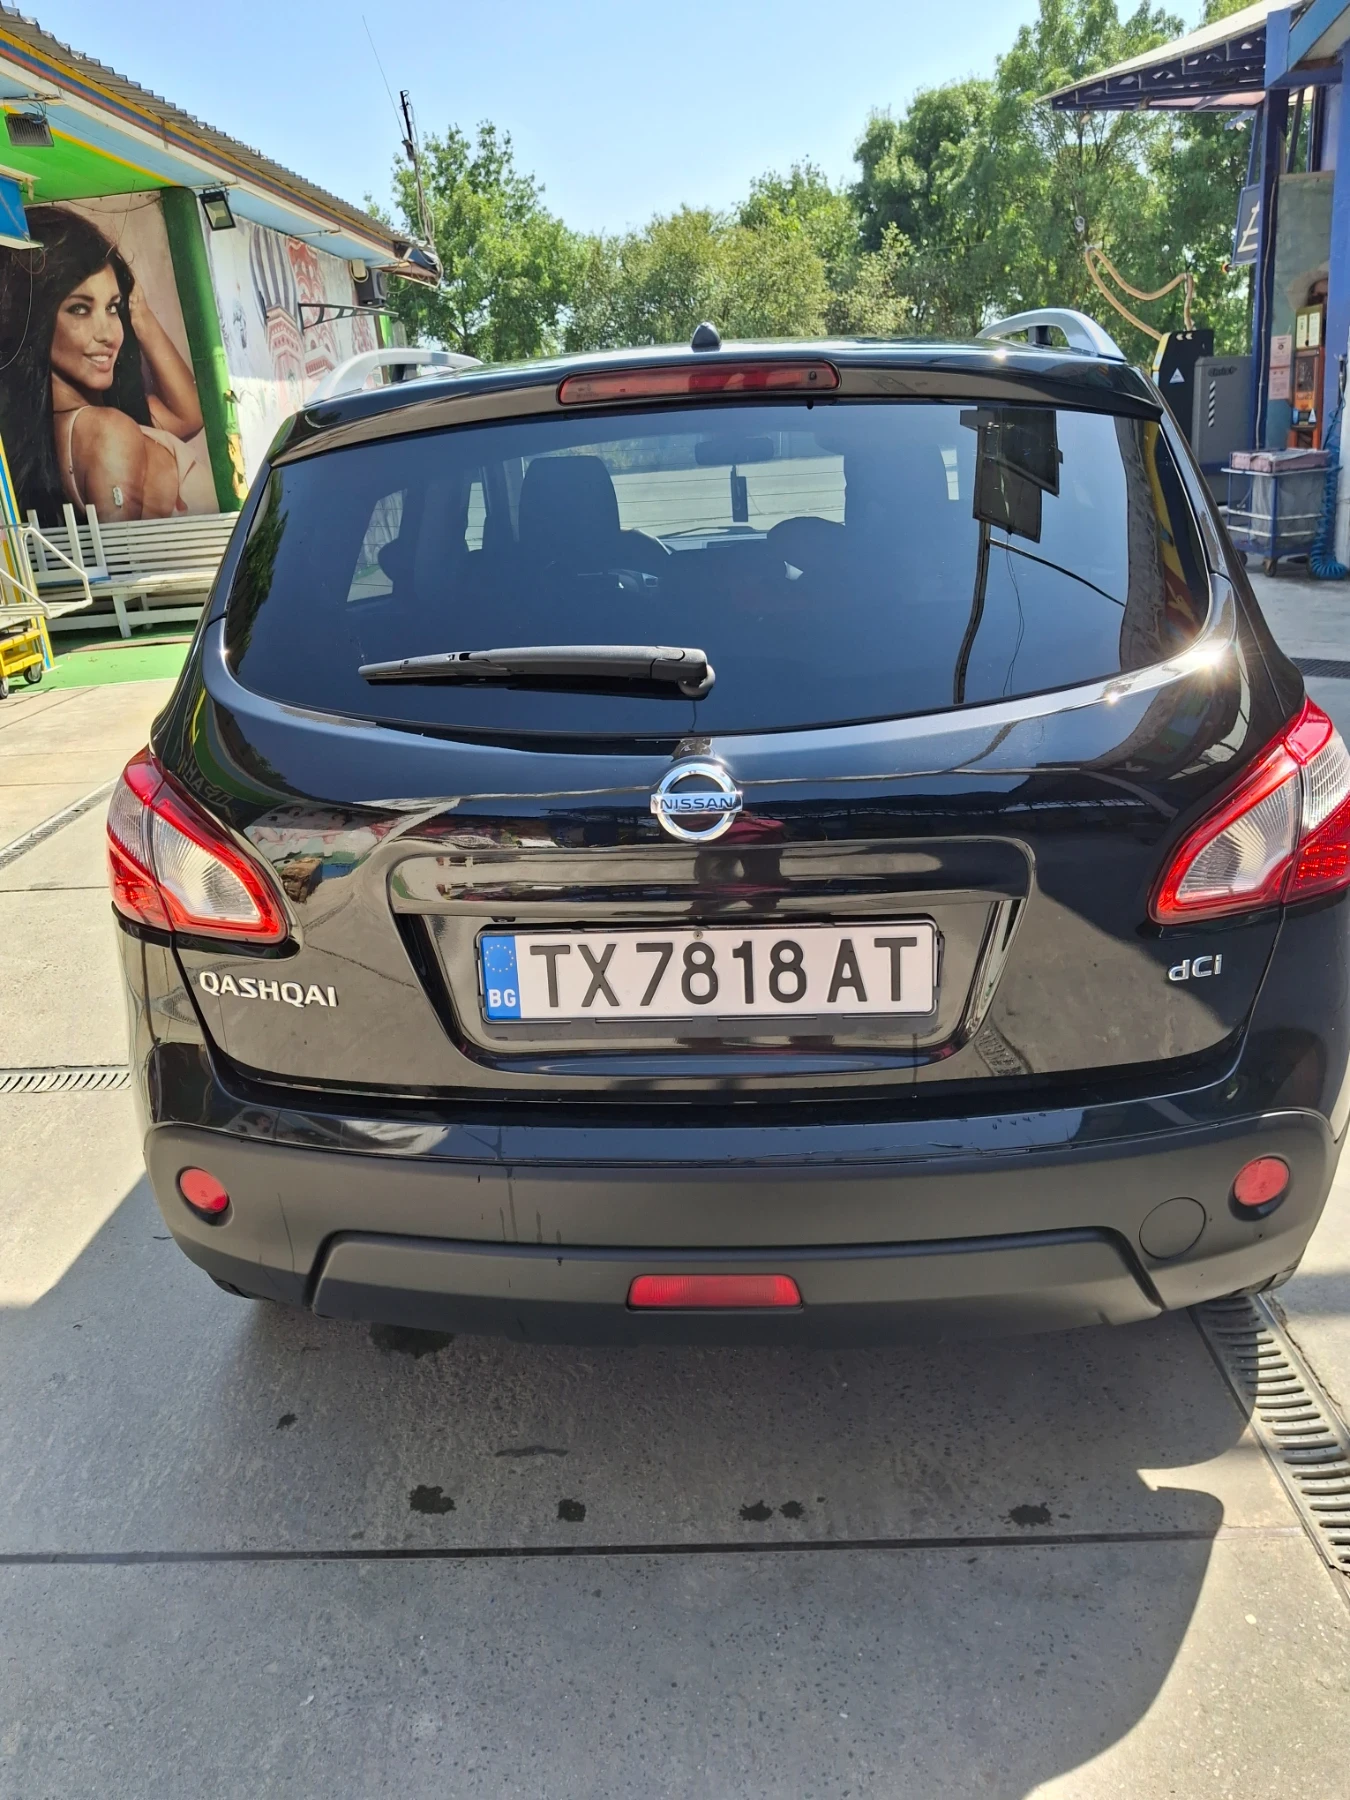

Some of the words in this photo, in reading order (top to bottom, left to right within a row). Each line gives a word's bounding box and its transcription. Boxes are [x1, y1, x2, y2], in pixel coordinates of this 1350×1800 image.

[660, 797, 733, 810] NISSAN
[199, 970, 339, 1008] QASHQAI
[488, 989, 516, 1008] BG
